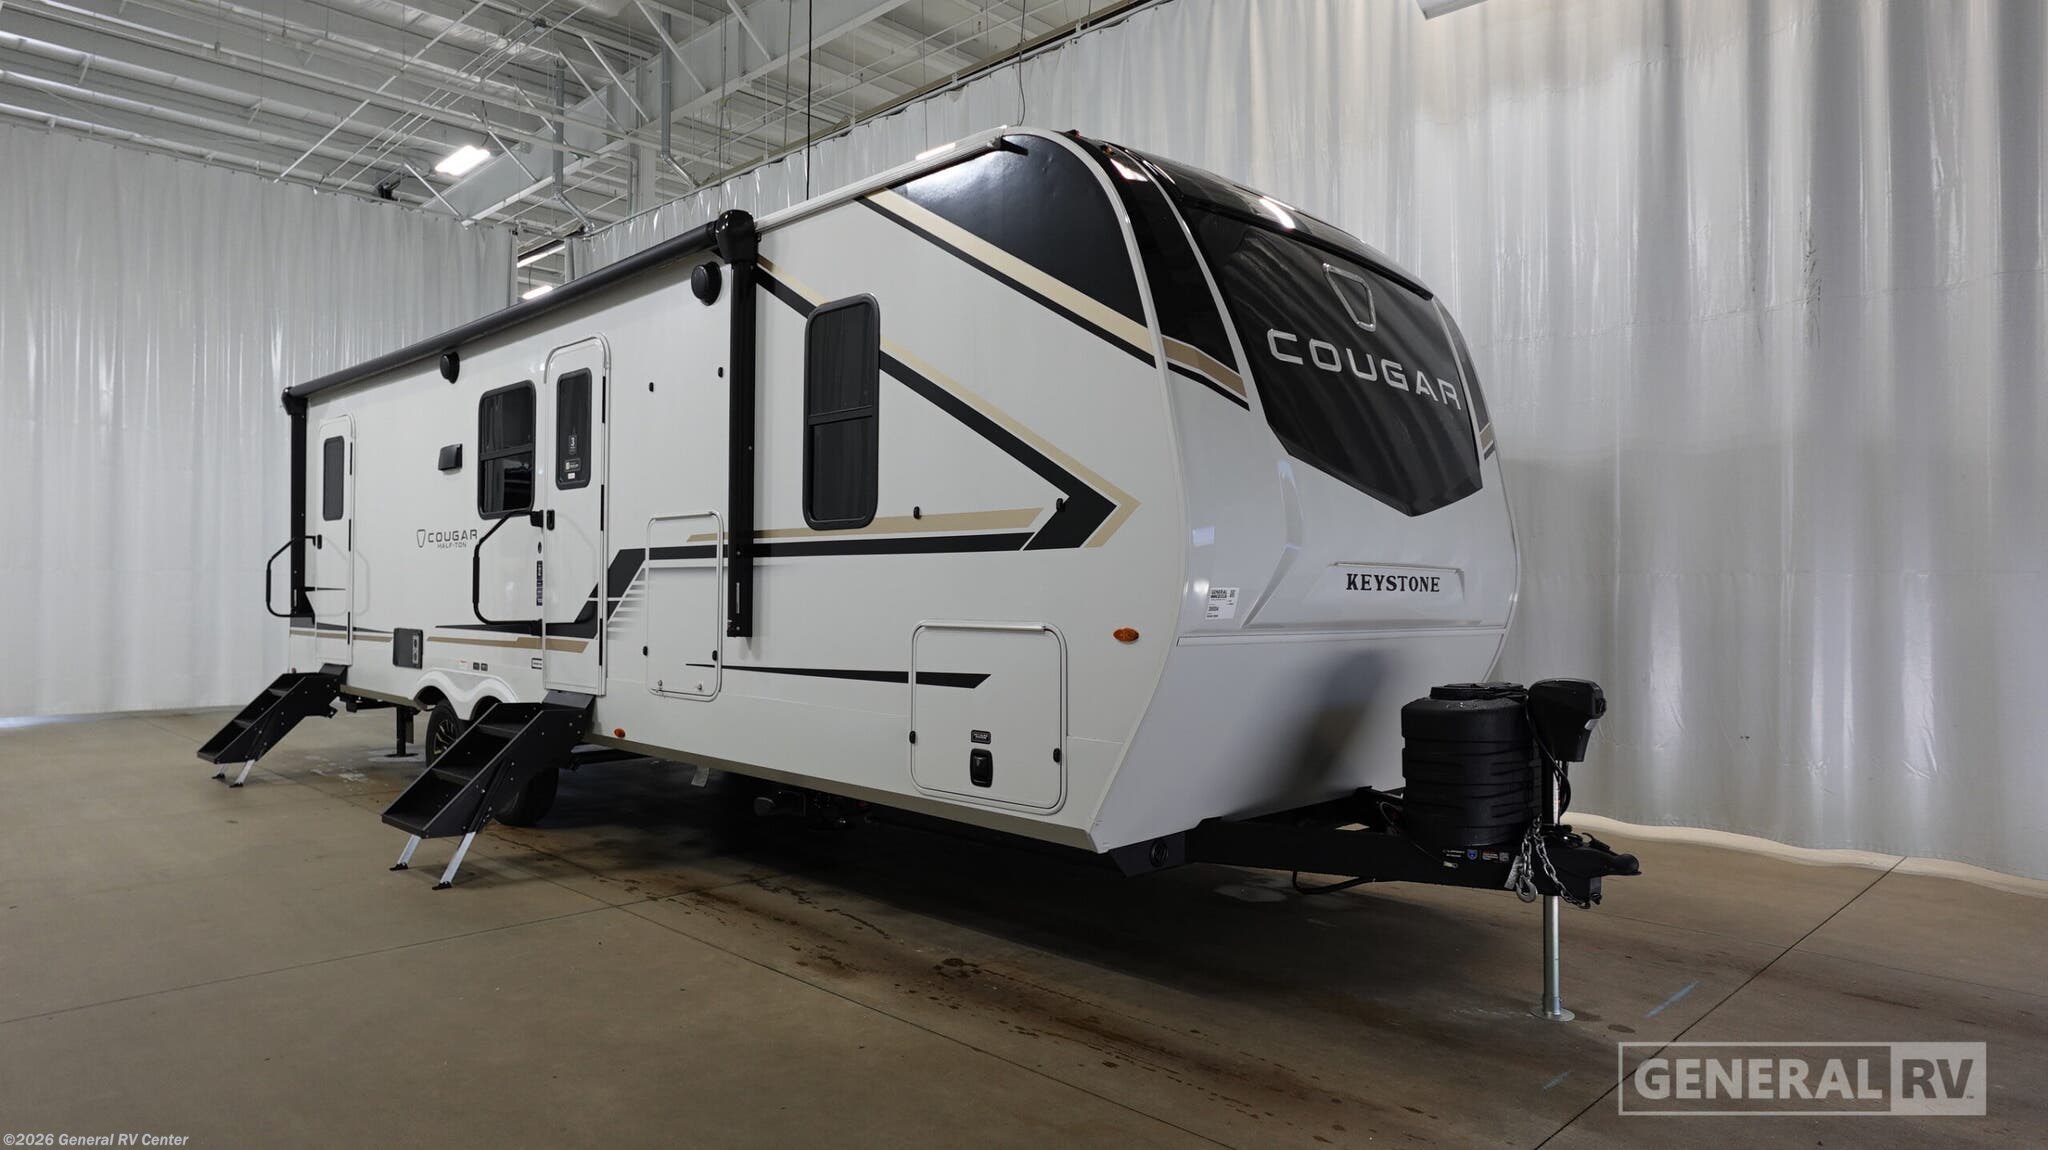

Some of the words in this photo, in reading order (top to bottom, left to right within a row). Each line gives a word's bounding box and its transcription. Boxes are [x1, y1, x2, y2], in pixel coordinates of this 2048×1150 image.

[1266, 328, 1462, 411] COUGAR
[427, 529, 478, 543] COUGAR
[1346, 573, 1441, 593] KEYSTONE
